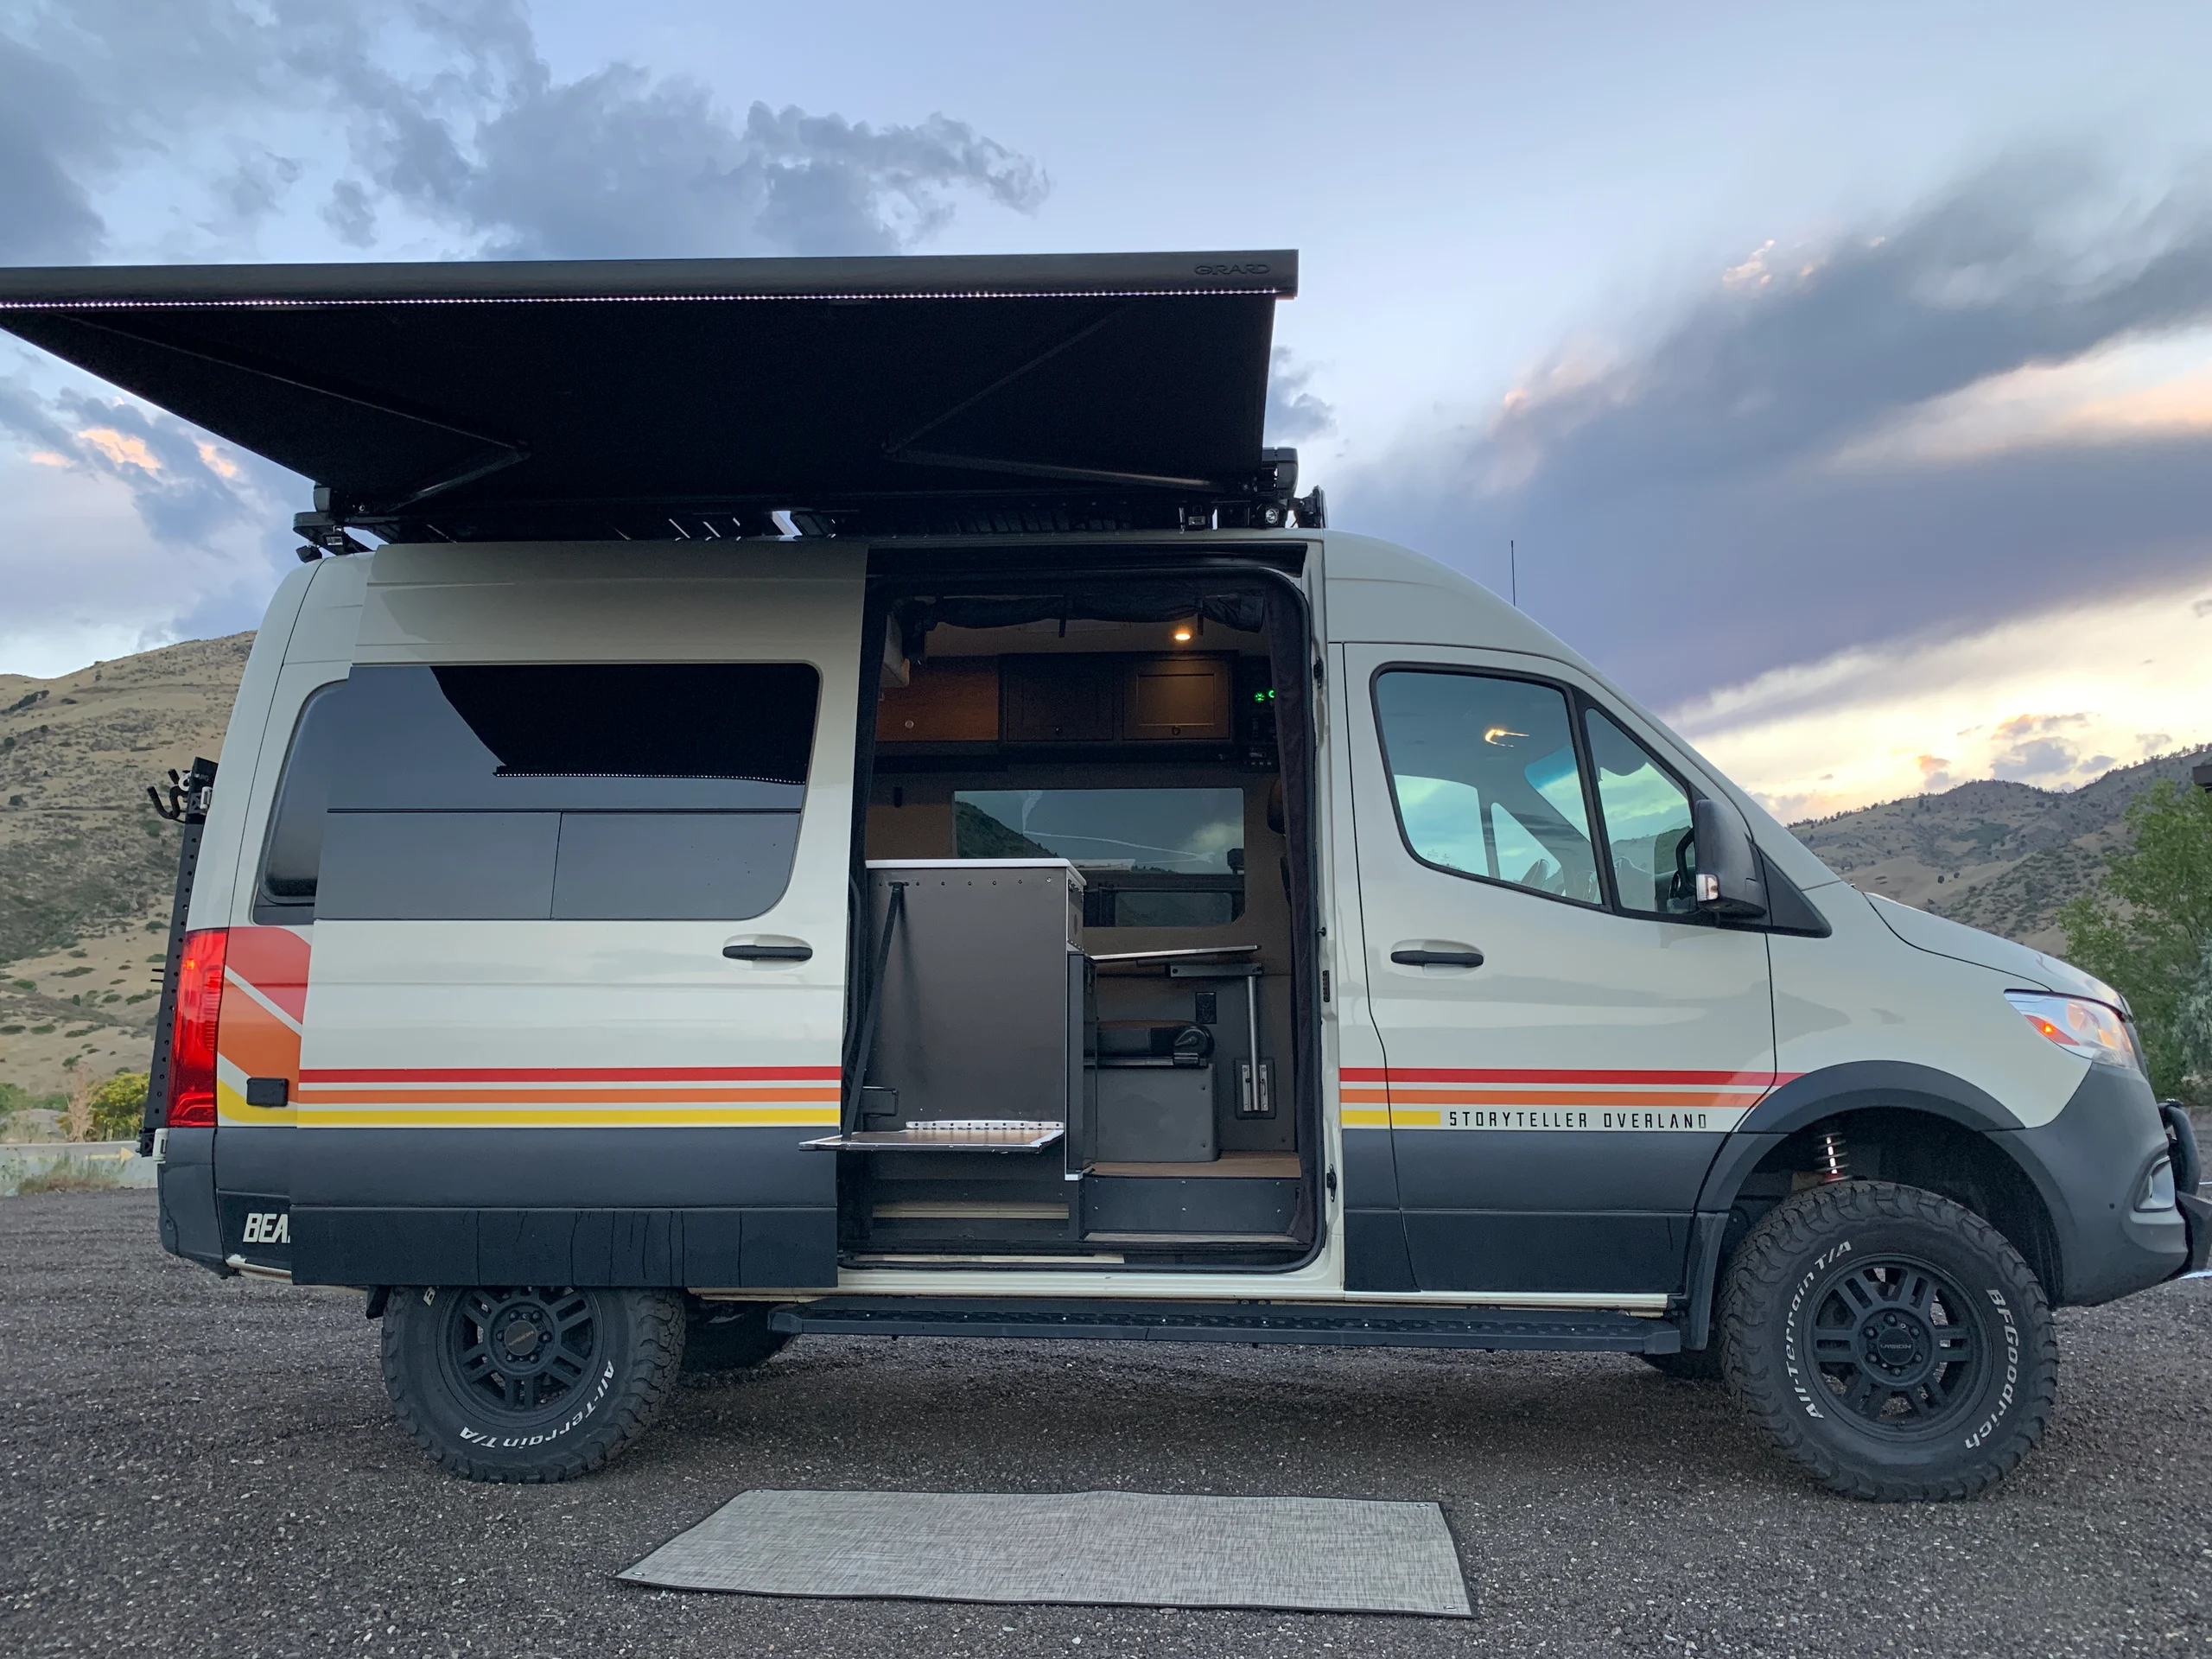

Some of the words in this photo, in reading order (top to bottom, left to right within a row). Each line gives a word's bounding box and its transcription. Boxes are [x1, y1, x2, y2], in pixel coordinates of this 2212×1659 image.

[1449, 1111, 1587, 1127] STORYTELLER
[1604, 1113, 1707, 1128] OVERLAND
[242, 1212, 291, 1243] BEA
[1815, 1241, 1853, 1270] T/A
[1964, 1289, 2019, 1449] BFGoodrich
[460, 1427, 498, 1448] T/A
